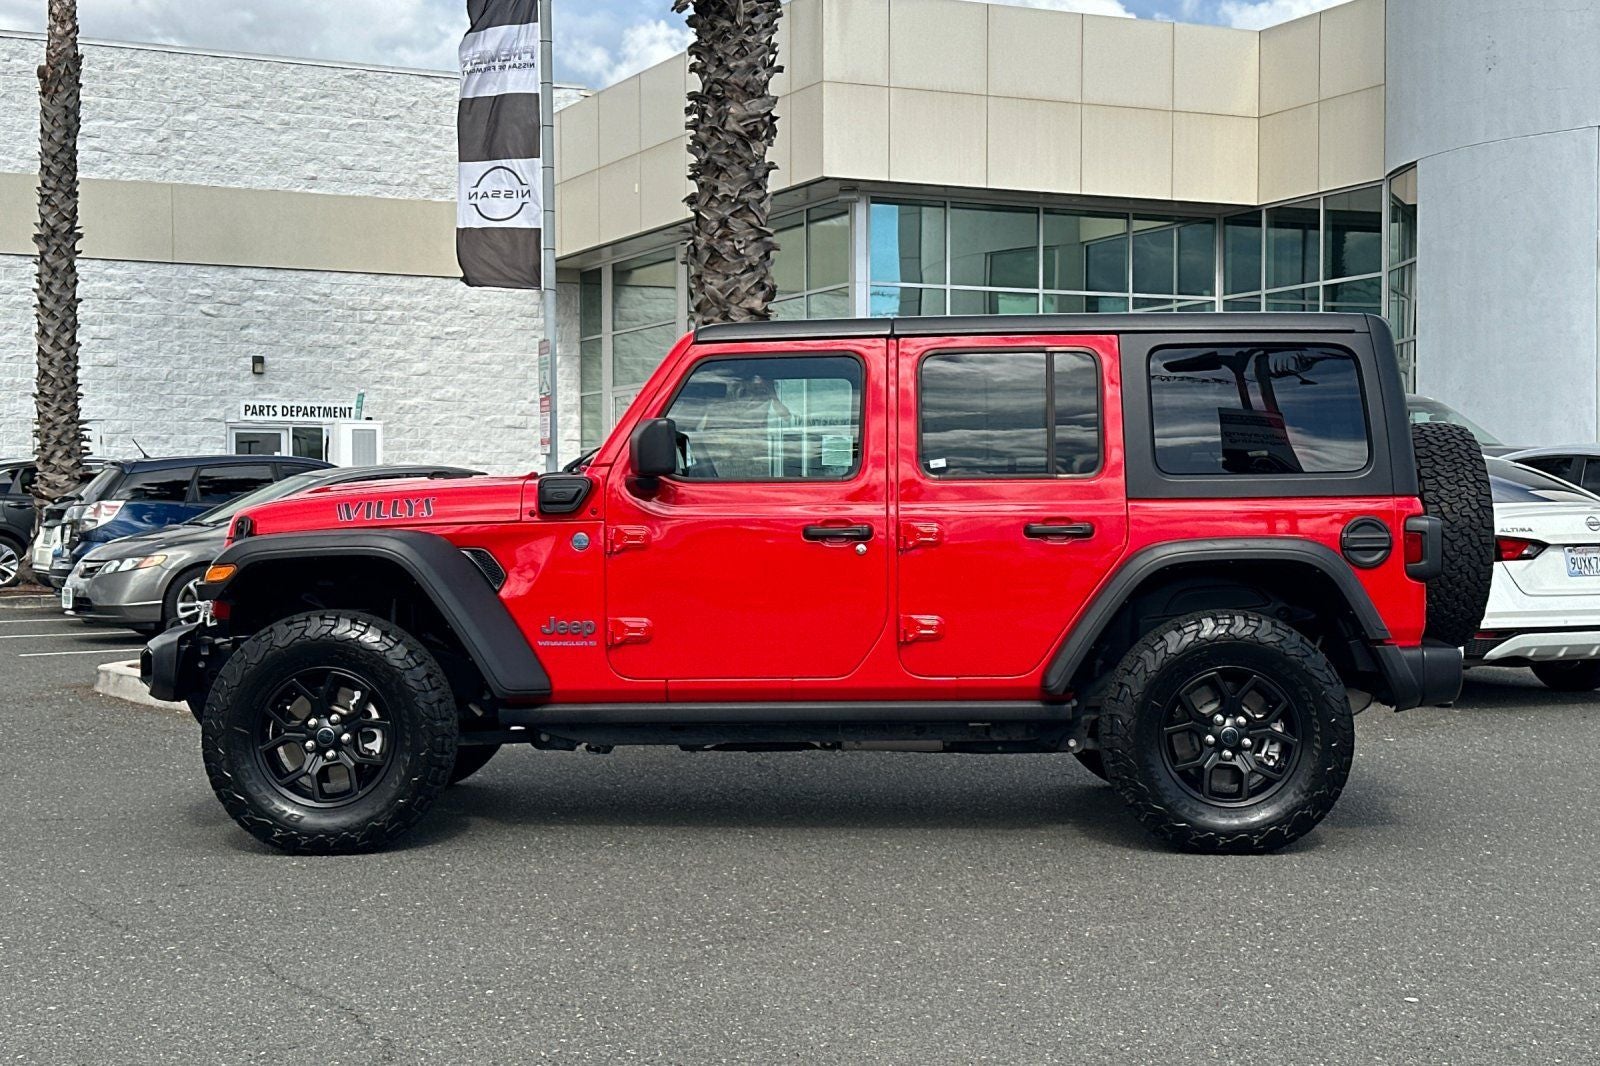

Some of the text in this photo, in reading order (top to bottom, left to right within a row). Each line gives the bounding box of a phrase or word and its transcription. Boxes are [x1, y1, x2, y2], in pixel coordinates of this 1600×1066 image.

[244, 404, 353, 419] PARTS DEPARTMENT
[336, 497, 437, 522] WILLYS
[541, 616, 596, 638] Jeep
